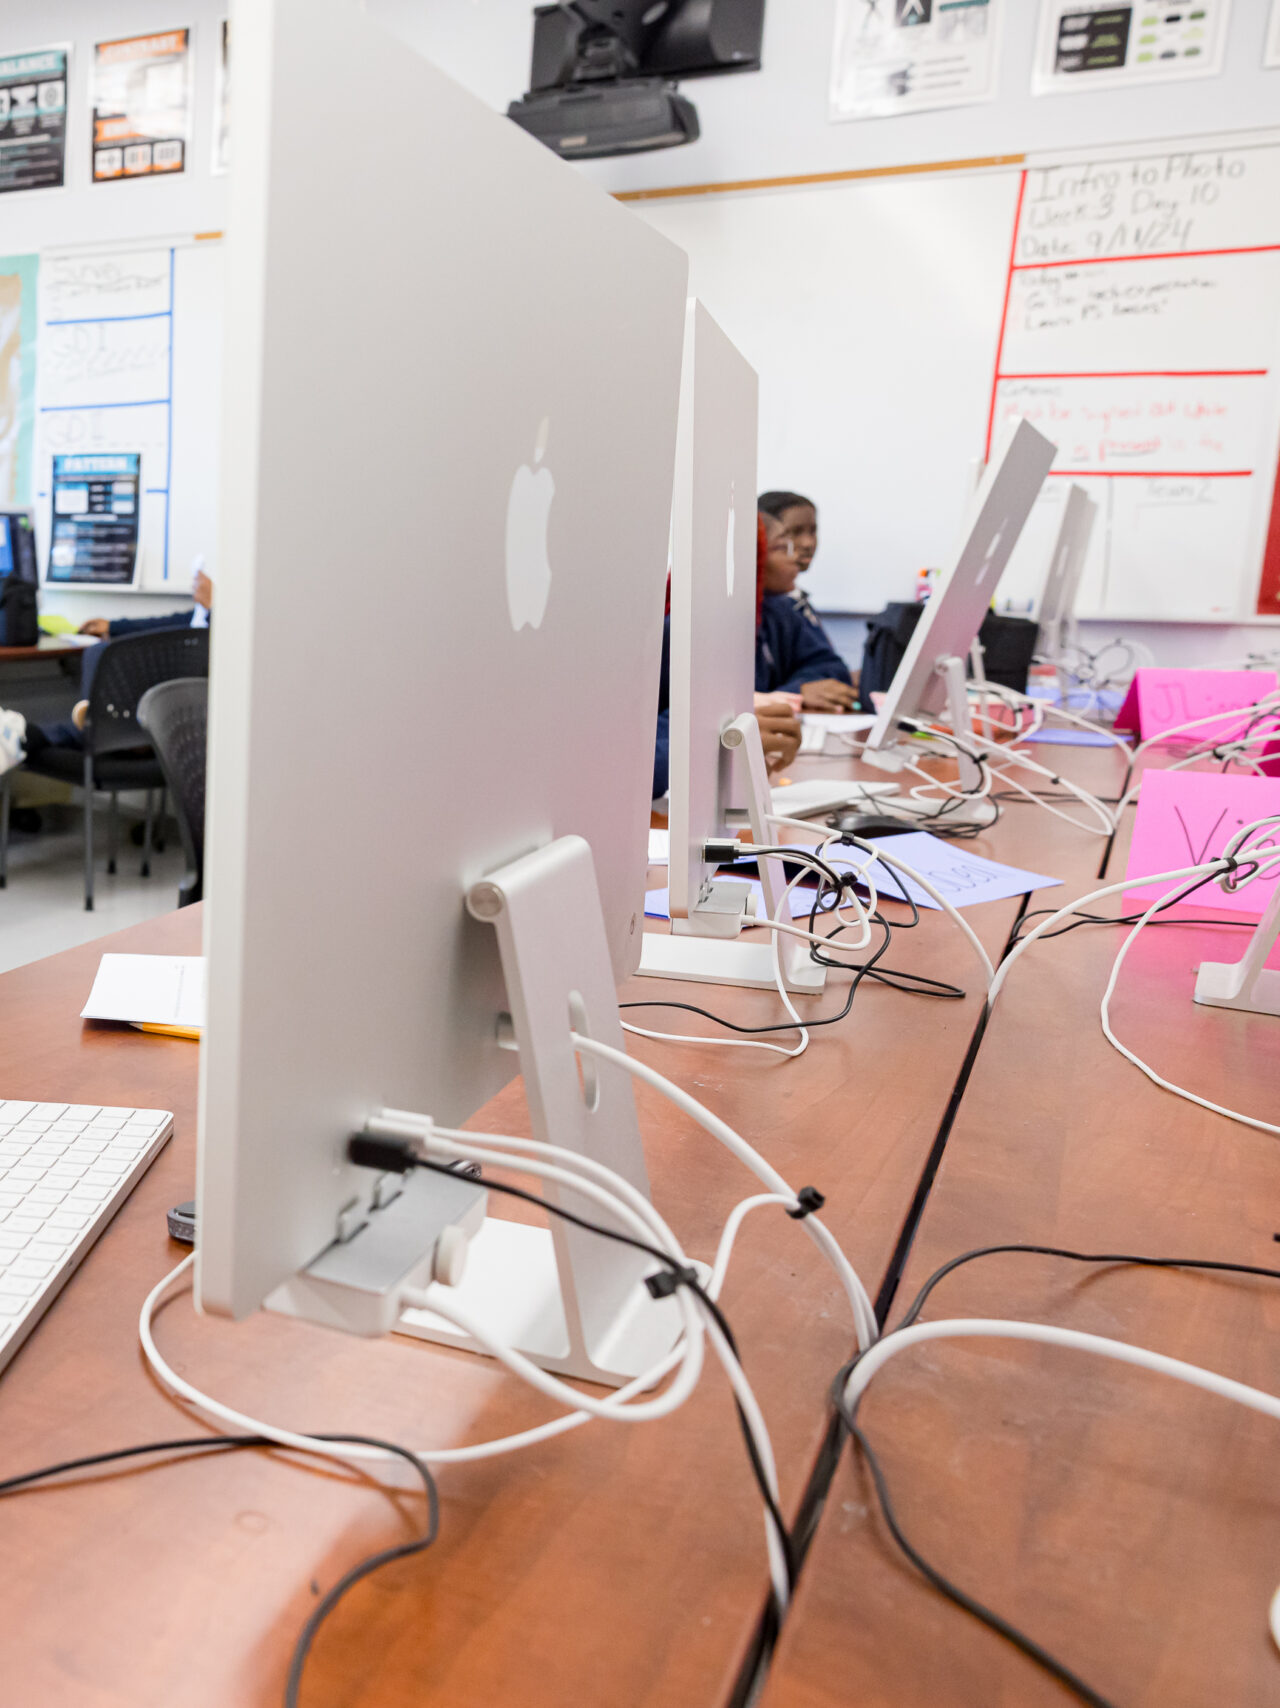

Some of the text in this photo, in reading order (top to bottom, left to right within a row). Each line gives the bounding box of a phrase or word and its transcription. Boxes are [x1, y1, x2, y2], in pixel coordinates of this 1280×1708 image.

[1031, 154, 1247, 203] Intro to Photo
[1130, 189, 1179, 218] Day
[1190, 181, 1221, 206] 10
